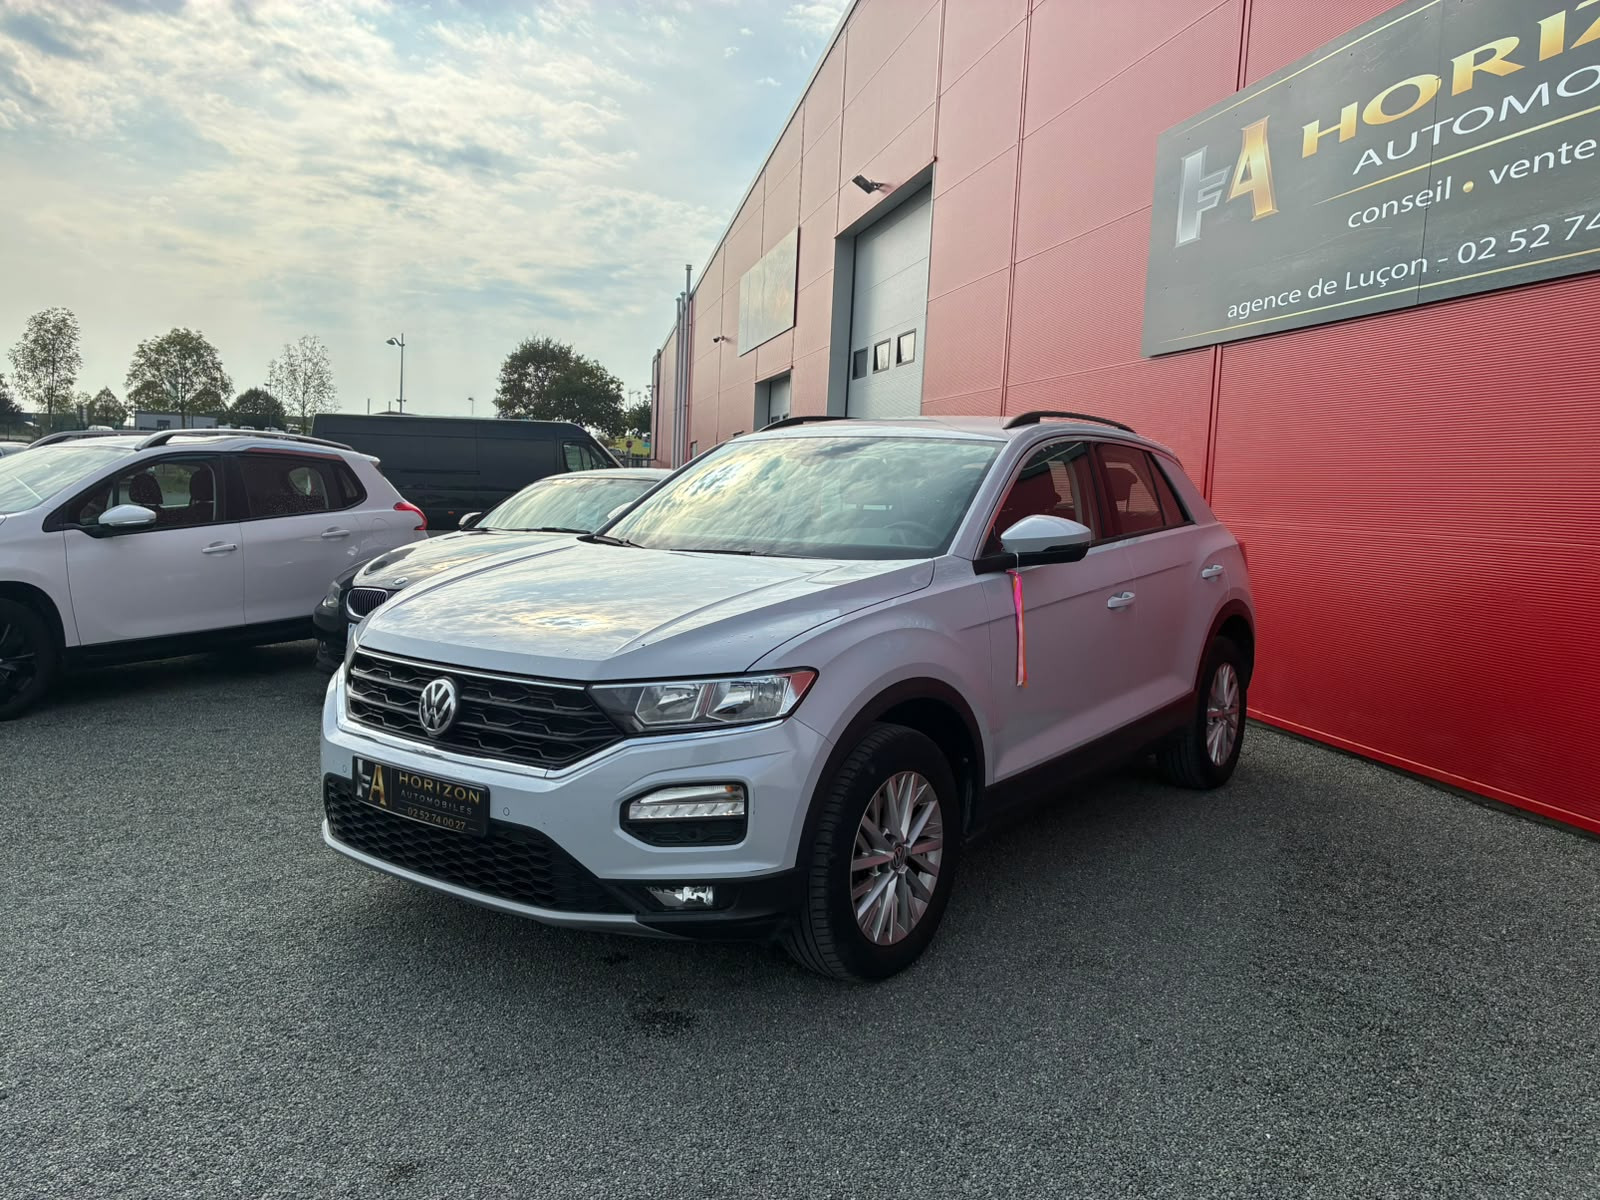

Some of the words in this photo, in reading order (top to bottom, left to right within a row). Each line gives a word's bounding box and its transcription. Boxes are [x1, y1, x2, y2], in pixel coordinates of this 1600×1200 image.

[1352, 65, 1600, 175] AUTOMO
[1348, 176, 1452, 229] conseil
[1488, 139, 1597, 185] vente
[1227, 286, 1302, 320] agence
[1308, 278, 1338, 300] de
[1345, 254, 1428, 292] Luçon
[1457, 236, 1496, 264] 02
[1507, 223, 1550, 253] 52
[399, 771, 481, 805] HORIZON
[401, 789, 473, 816] AUTOMOBILES
[407, 806, 419, 817] 02
[419, 809, 430, 820] 52
[431, 812, 441, 823] 74
[442, 816, 455, 827] 00
[455, 820, 467, 831] 27
